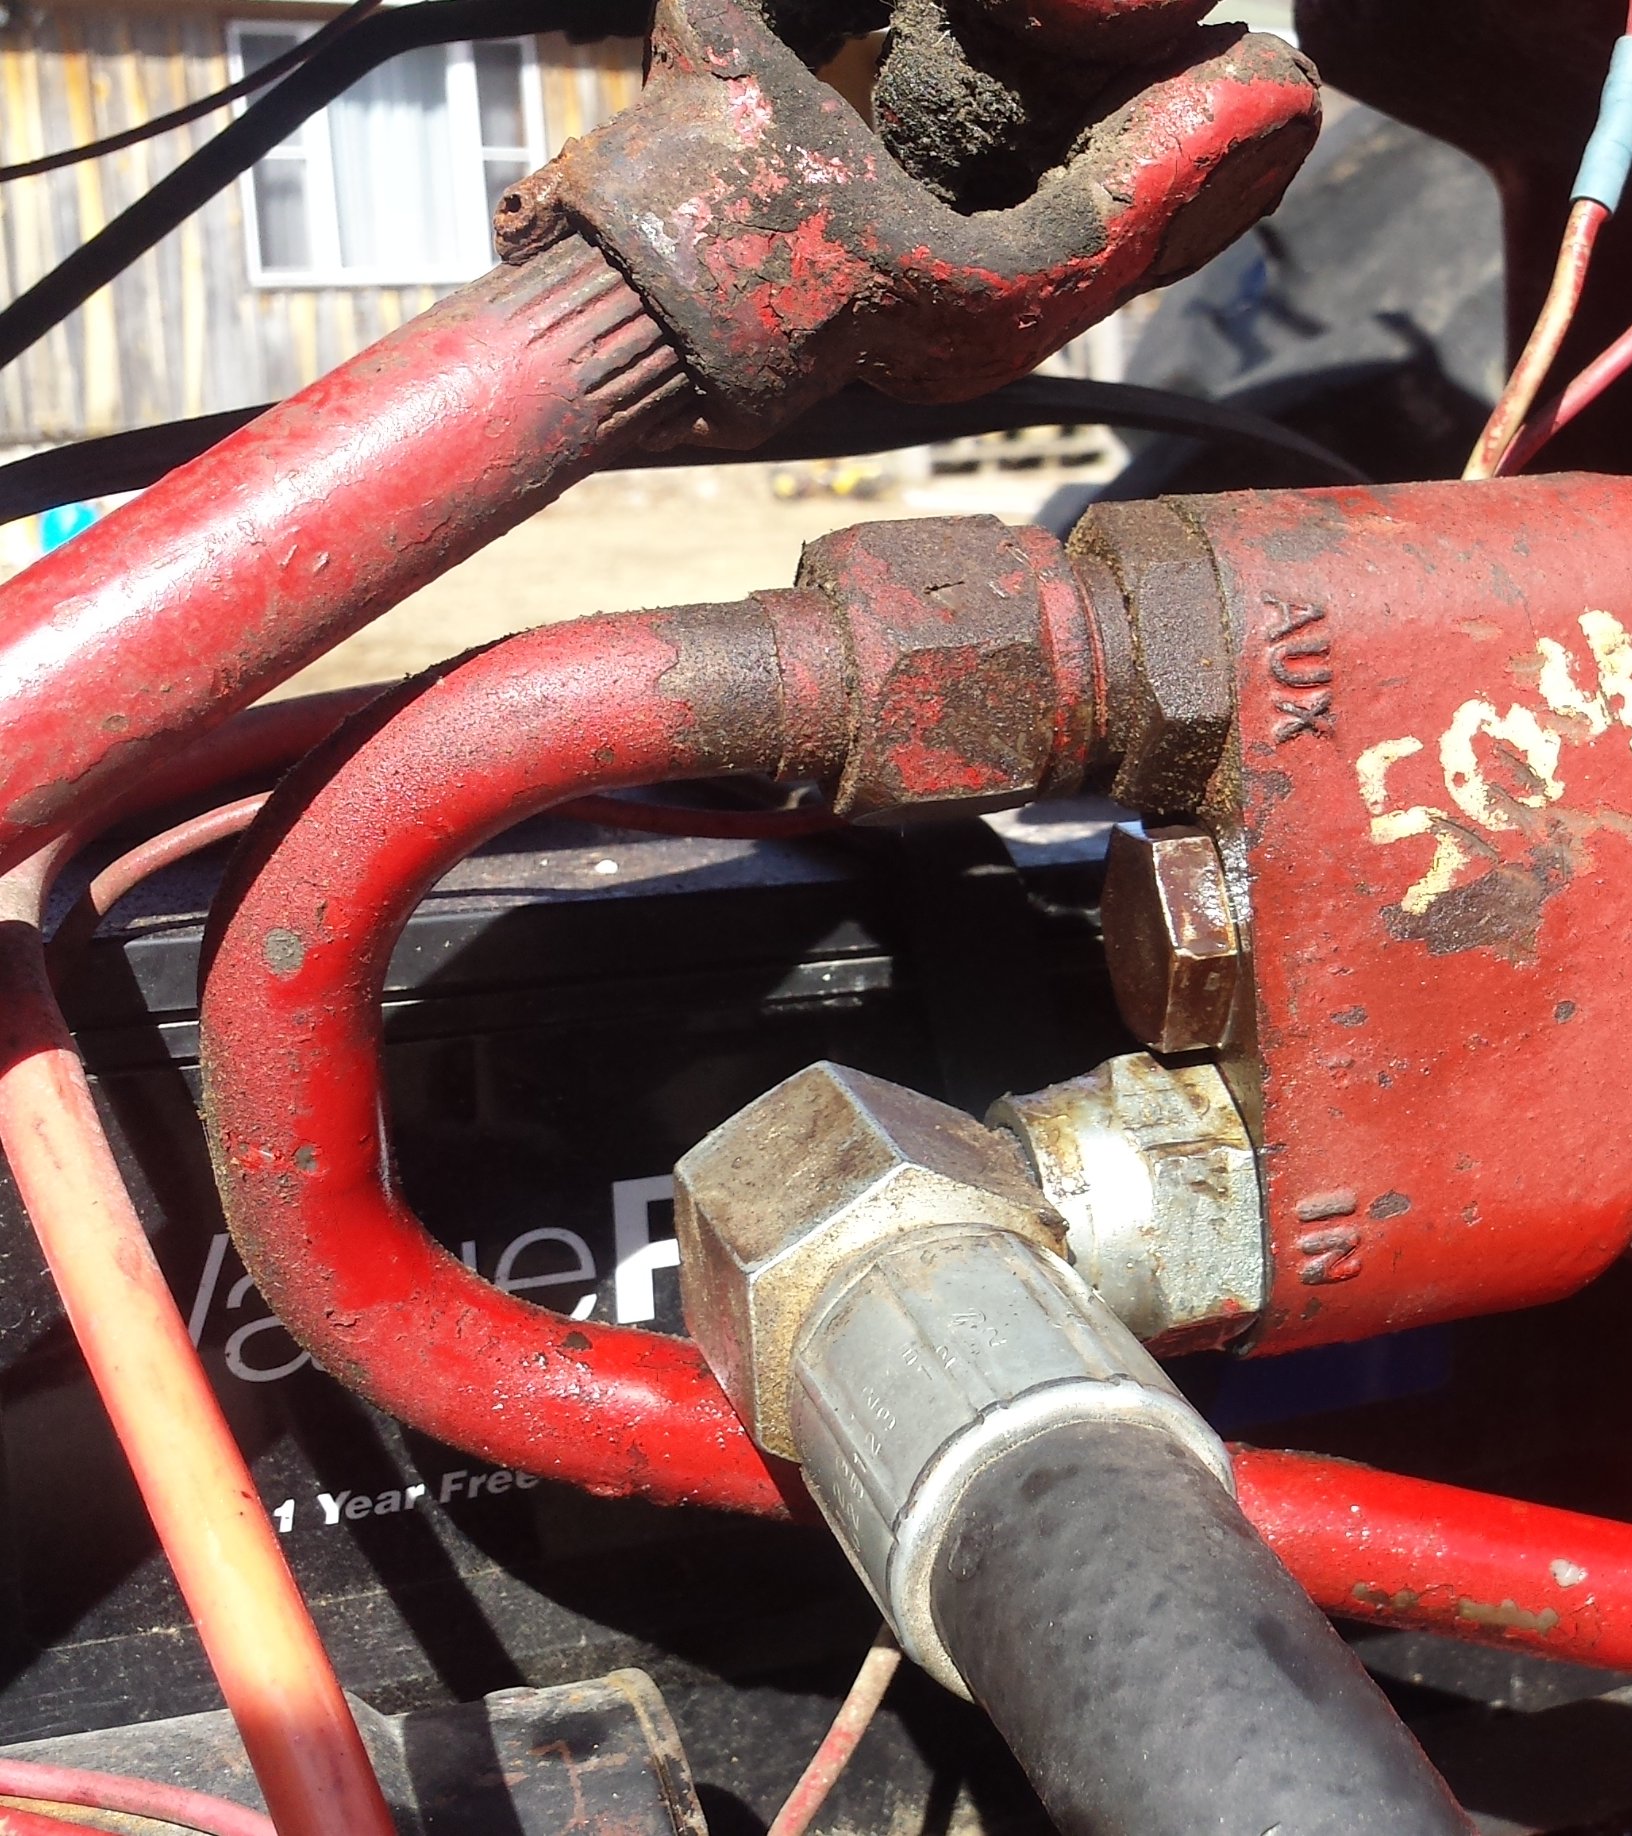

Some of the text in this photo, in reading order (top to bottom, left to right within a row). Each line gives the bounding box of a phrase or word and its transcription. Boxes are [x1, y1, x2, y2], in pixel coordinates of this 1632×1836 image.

[1264, 591, 1334, 744] AUX
[1296, 1188, 1362, 1286] IN
[273, 1465, 540, 1533] 1 Year Free
